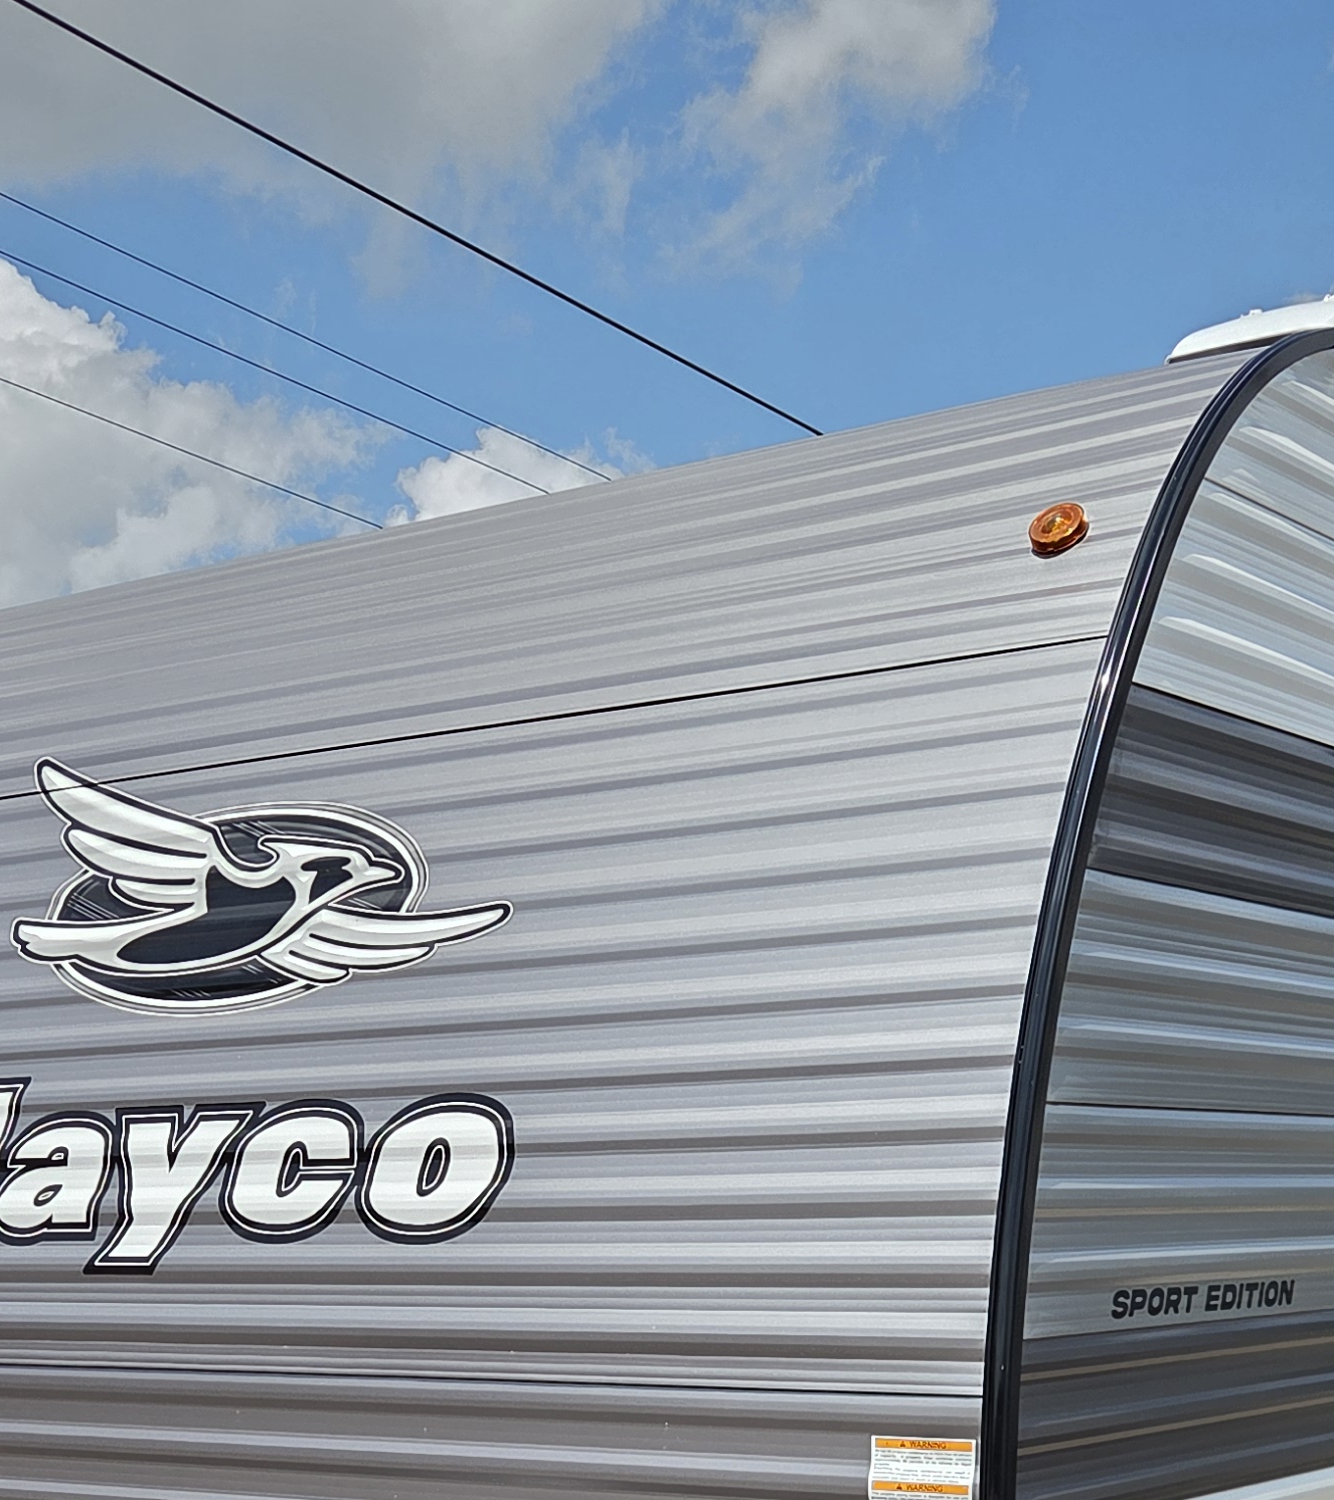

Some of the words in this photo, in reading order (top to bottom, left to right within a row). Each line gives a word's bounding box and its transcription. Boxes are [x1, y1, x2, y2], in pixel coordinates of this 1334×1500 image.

[1111, 1286, 1199, 1319] SPORT
[1204, 1279, 1295, 1311] EDITION
[910, 1440, 947, 1450] WARNING
[907, 1482, 944, 1492] WARNING
